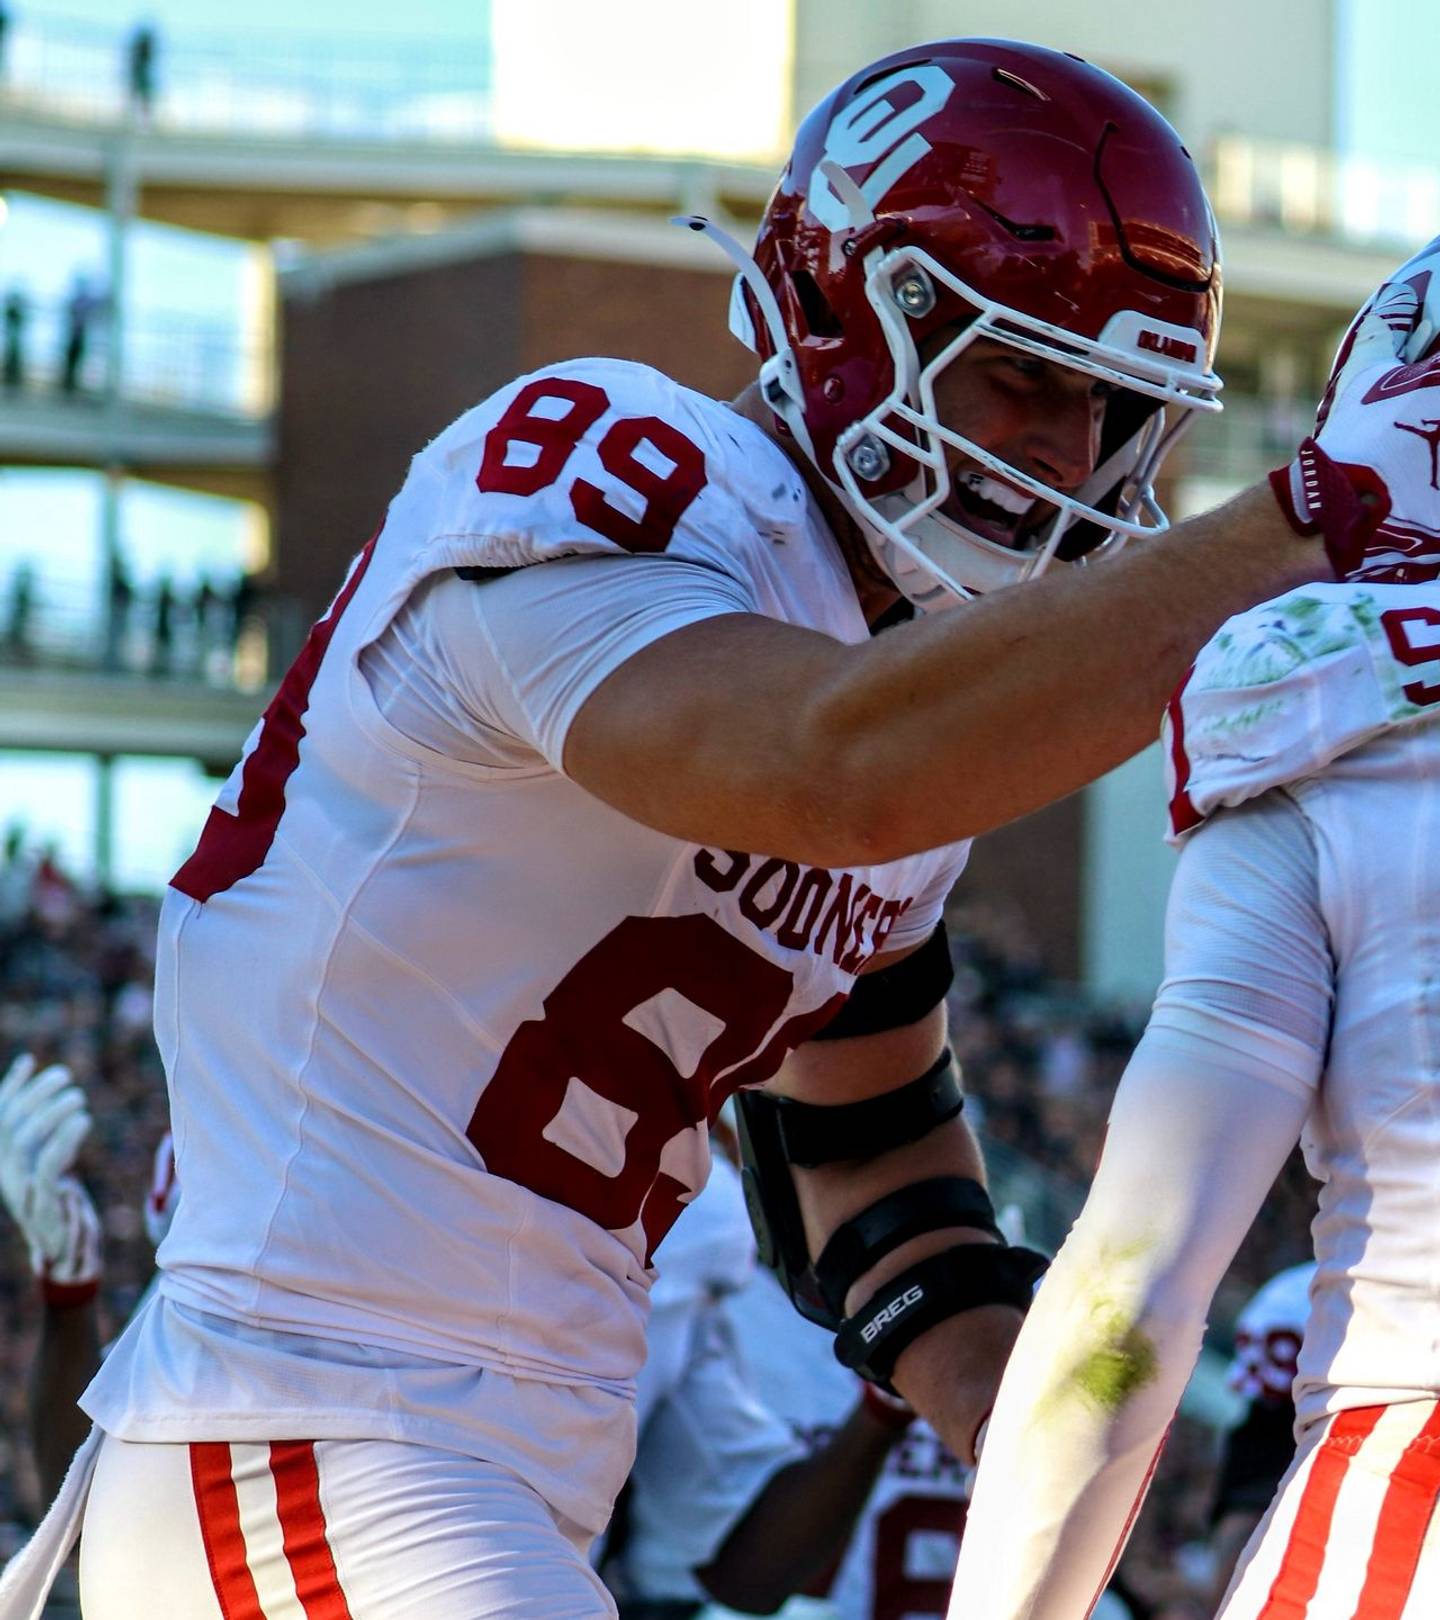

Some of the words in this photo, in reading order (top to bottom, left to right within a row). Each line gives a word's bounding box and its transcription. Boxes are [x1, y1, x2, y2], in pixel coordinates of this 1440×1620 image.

[476, 377, 708, 553] 89
[1301, 449, 1322, 510] JORDAN
[861, 1285, 924, 1343] BREG
